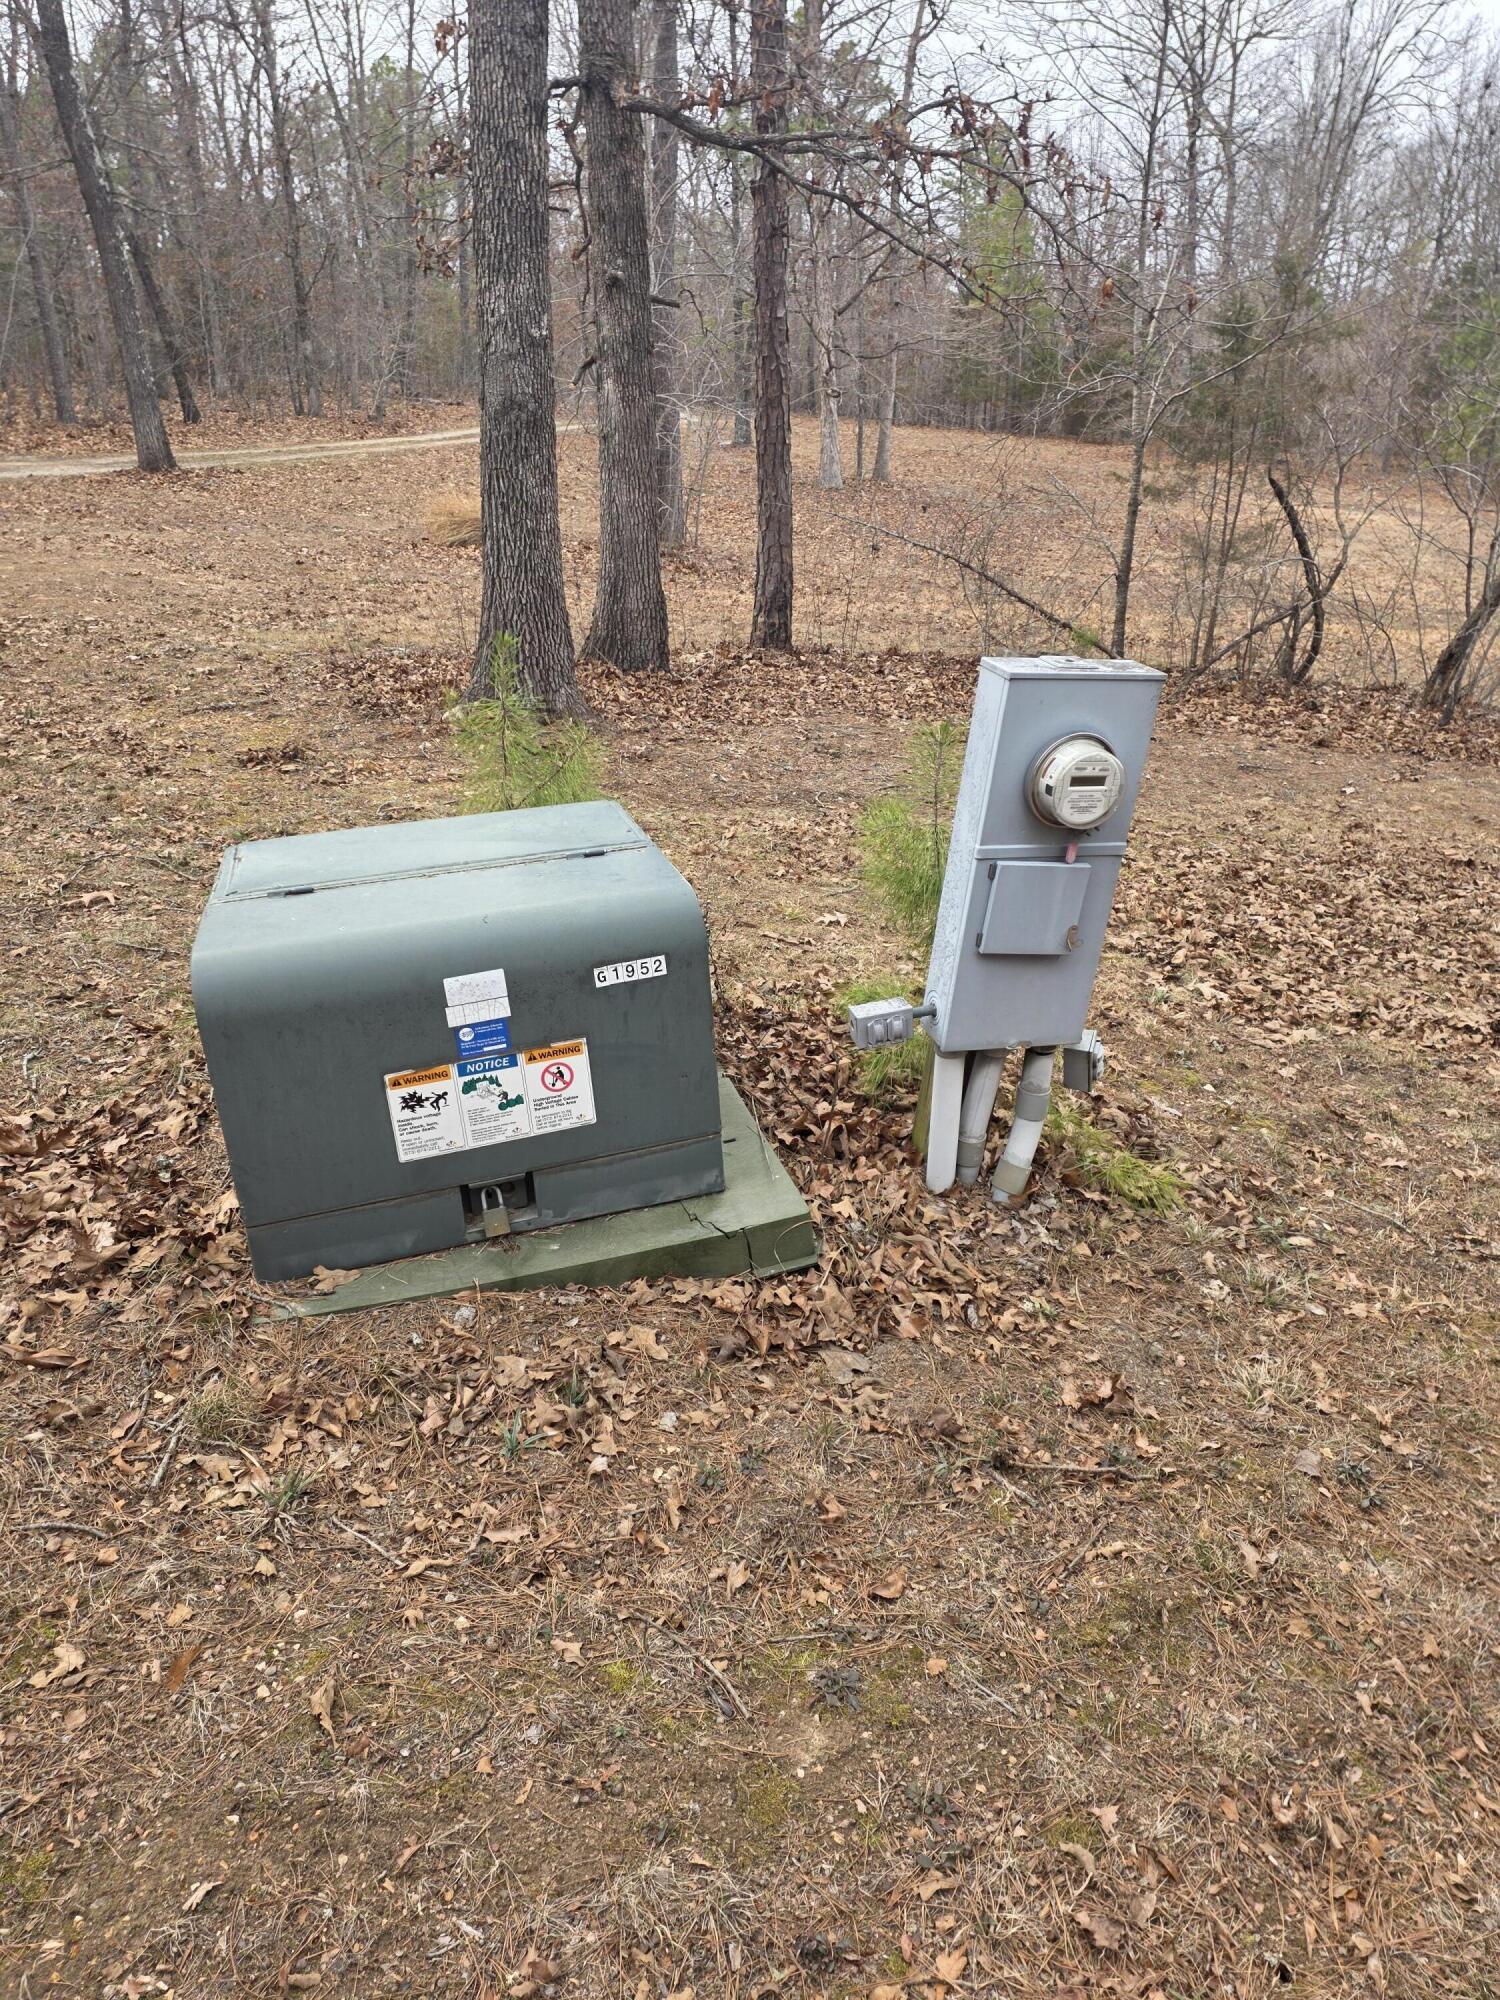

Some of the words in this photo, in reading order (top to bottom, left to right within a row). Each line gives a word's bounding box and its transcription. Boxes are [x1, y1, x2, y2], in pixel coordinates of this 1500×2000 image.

[597, 959, 662, 982] G1952
[538, 1046, 581, 1060] WARNING
[466, 1057, 510, 1073] NOTICE
[402, 1070, 448, 1085] WARNING
